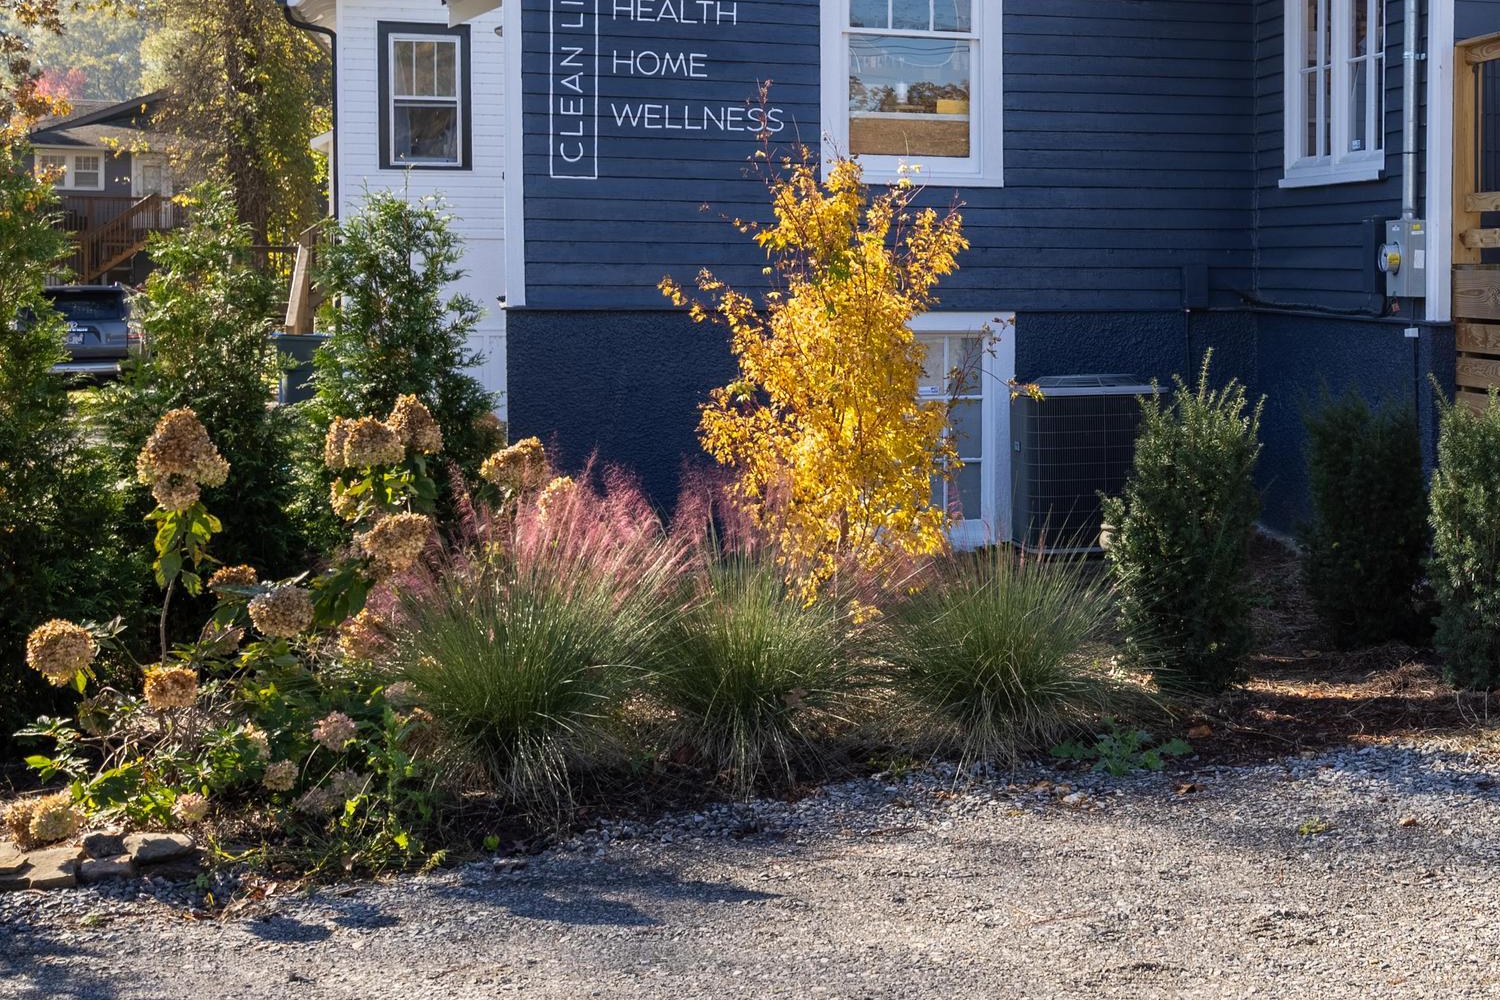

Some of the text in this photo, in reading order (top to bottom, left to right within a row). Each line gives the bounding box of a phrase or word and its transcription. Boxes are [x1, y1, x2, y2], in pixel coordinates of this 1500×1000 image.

[612, 49, 708, 78] HOME
[560, 46, 584, 163] CLEAN
[611, 103, 784, 132] WELLNESS
